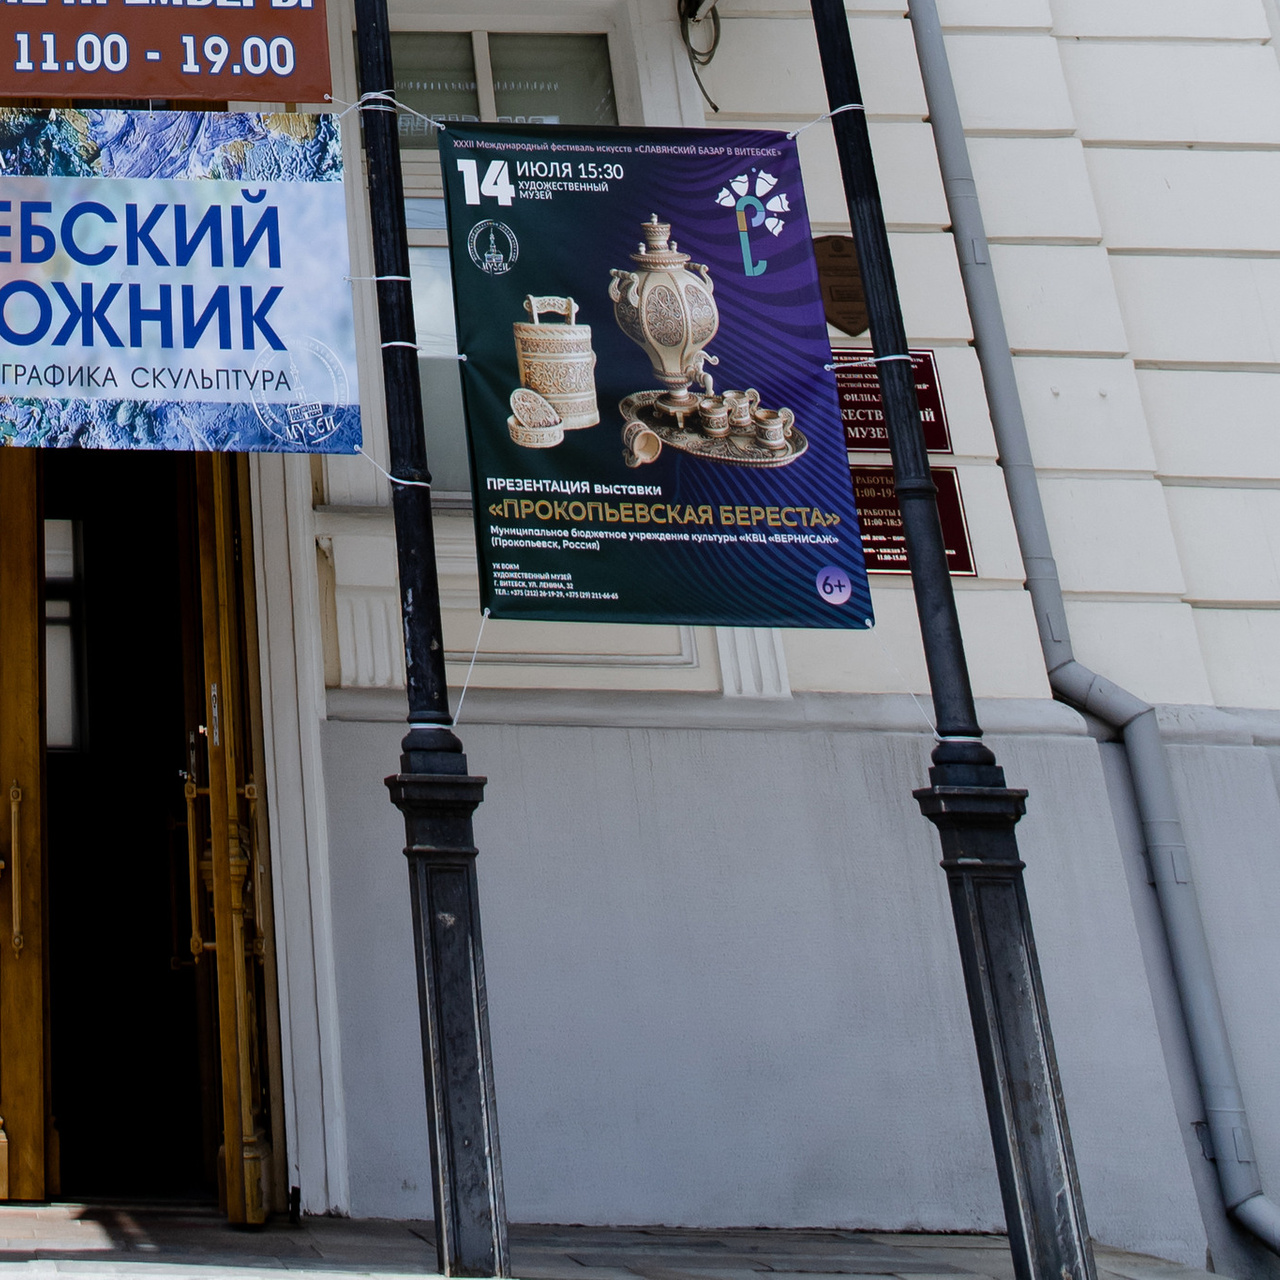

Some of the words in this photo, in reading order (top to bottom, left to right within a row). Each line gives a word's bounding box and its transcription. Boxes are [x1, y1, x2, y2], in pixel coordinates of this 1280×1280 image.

[14, 32, 129, 73] 11.00
[181, 34, 296, 76] 19.00
[476, 140, 549, 151] Международный
[550, 142, 595, 153] фестиваль
[596, 144, 632, 154] искусств
[634, 144, 697, 155] «СЛАВЯНСКИЙ
[698, 146, 725, 156] БАЗАР
[726, 146, 733, 156] В
[734, 147, 782, 157] ВИТЕБСКЕ»
[516, 161, 573, 178] ИЮЛЯ
[577, 162, 624, 179] 15:30
[456, 158, 516, 206] 14
[518, 180, 609, 192] ХУДОЖЕСТВЕННЫЙ
[519, 189, 553, 200] МУЗЕЙ
[1, 363, 118, 388] ГРАФИКА
[131, 366, 292, 391] СКУЛЬПТУРА
[487, 477, 590, 495] ПРЕЗЕНТАЦИЯ
[594, 483, 662, 496] выставки
[855, 475, 895, 485] РАБОТЫ
[488, 498, 714, 525] «ПРОКОПЬЕВСКАЯ
[719, 505, 841, 527] БЕРЕСТА»
[863, 508, 897, 517] РАБОТЫ
[490, 525, 569, 538] Муниципальное
[571, 528, 627, 540] бюджетное
[629, 530, 690, 542] учреждение
[691, 533, 738, 544] культуры
[739, 533, 767, 544] «КВЦ
[768, 533, 839, 544] «ВЕРНИСАЖ»
[491, 537, 561, 550] (Прокопьевск,
[562, 539, 600, 551] Россия)
[550, 572, 572, 581] МУЗЕЙ
[821, 575, 846, 595] 6+
